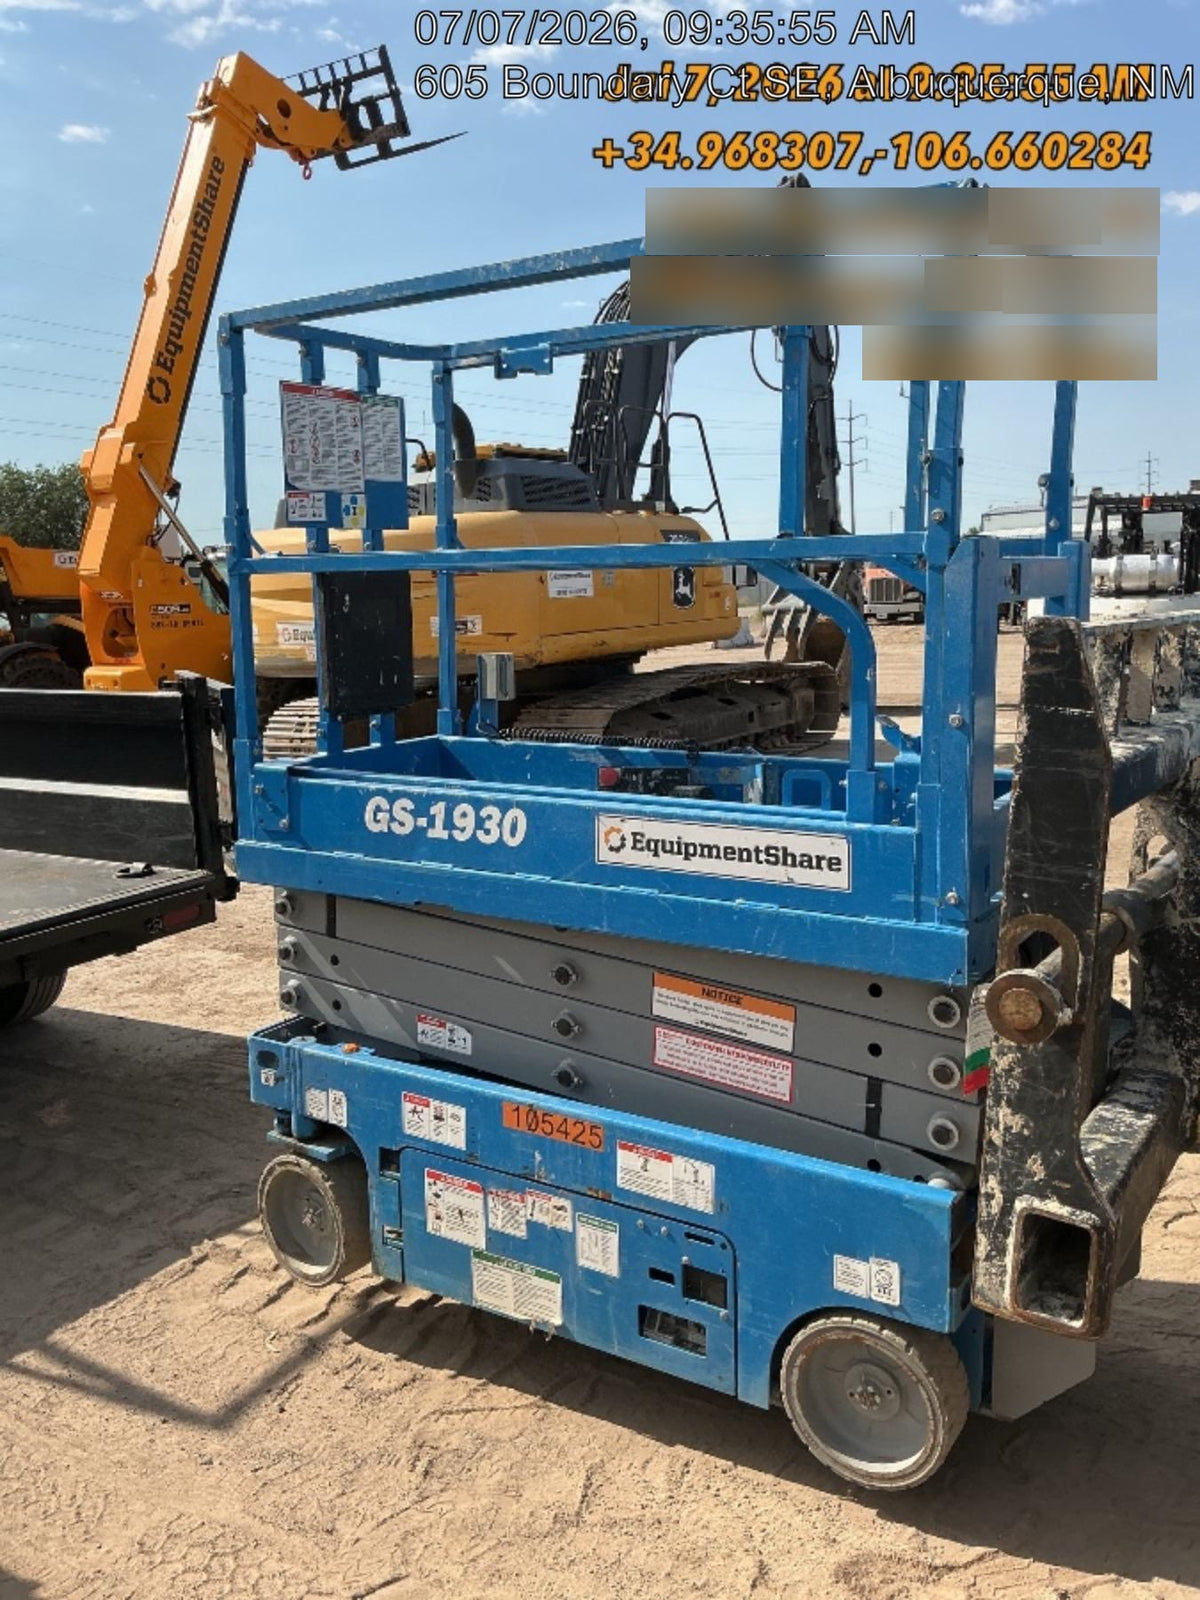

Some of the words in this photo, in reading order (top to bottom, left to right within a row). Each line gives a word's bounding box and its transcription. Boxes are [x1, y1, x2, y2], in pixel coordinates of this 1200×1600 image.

[156, 155, 225, 375] EquipmentShare
[364, 795, 528, 847] GS-1930
[630, 831, 843, 872] EquipmentShare
[701, 986, 744, 1006] NOTICE
[512, 1105, 602, 1149] 105425
